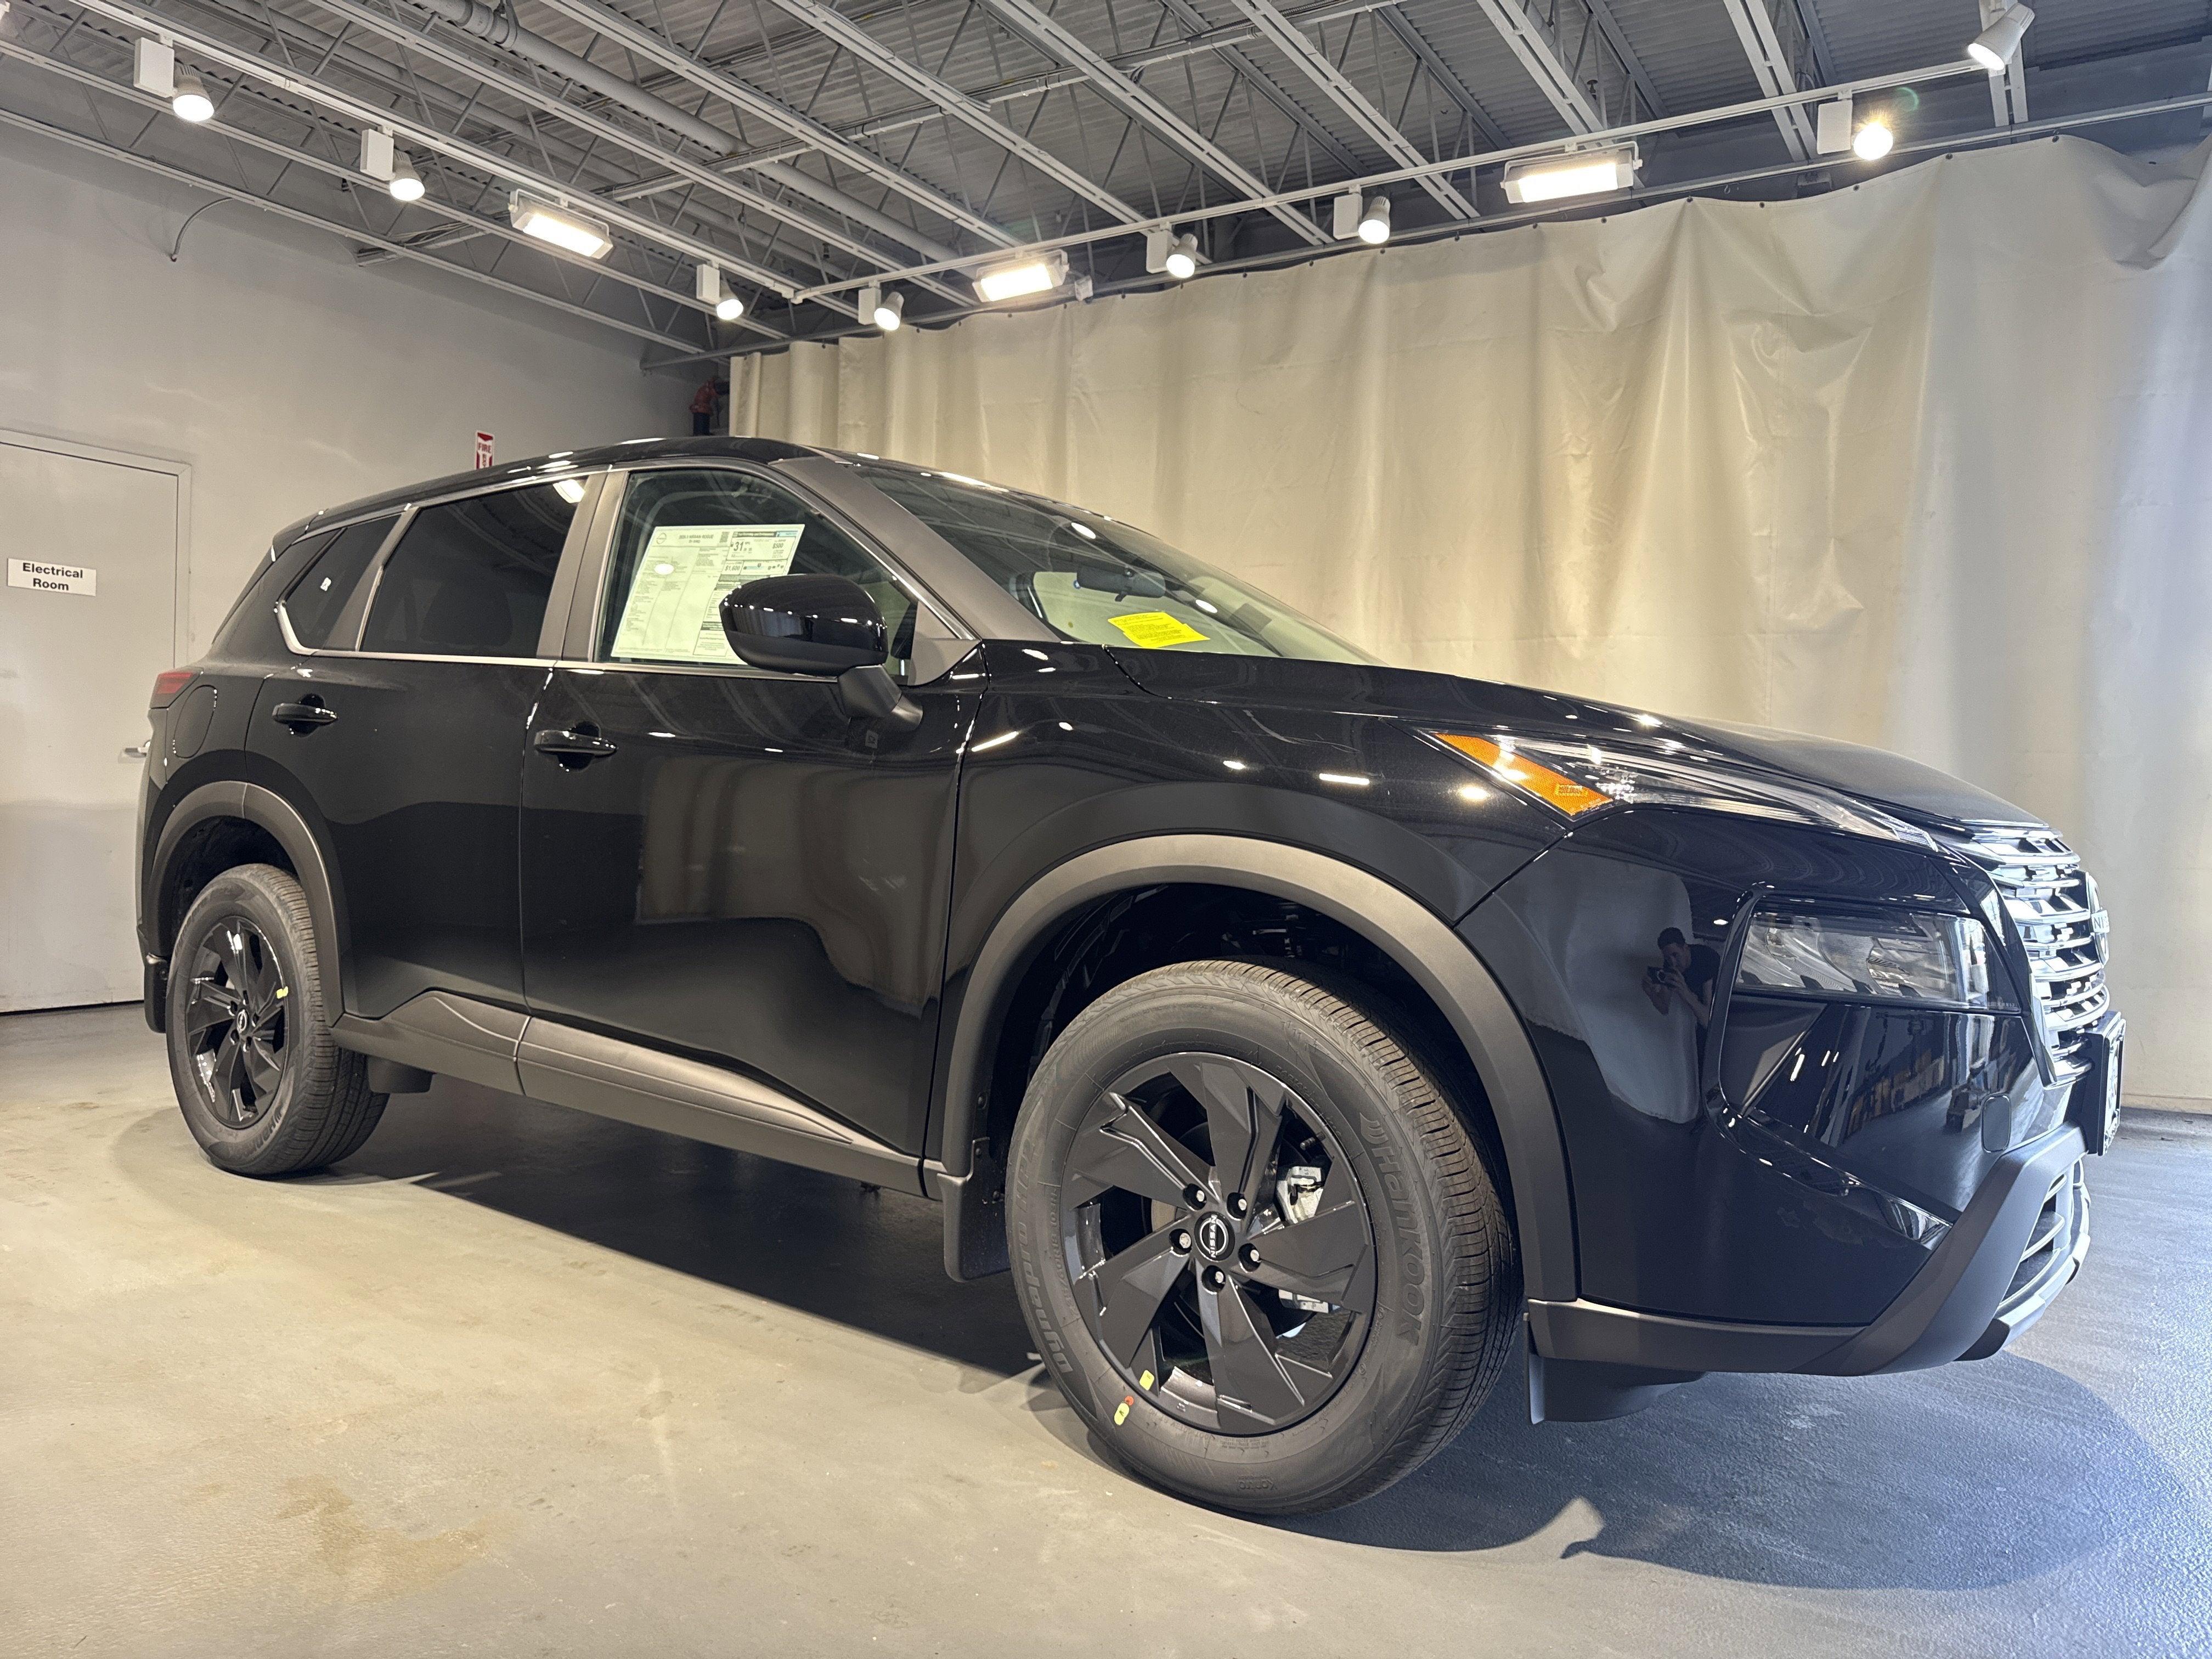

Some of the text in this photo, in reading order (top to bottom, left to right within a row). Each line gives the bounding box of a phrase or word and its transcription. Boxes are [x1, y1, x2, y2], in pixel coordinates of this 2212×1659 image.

[478, 442, 492, 453] FIRE
[733, 541, 744, 551] 31
[22, 562, 83, 578] Electrical
[33, 578, 69, 591] Room
[1210, 1214, 1218, 1258] NISSAN
[1018, 1221, 1073, 1373] Dynapro
